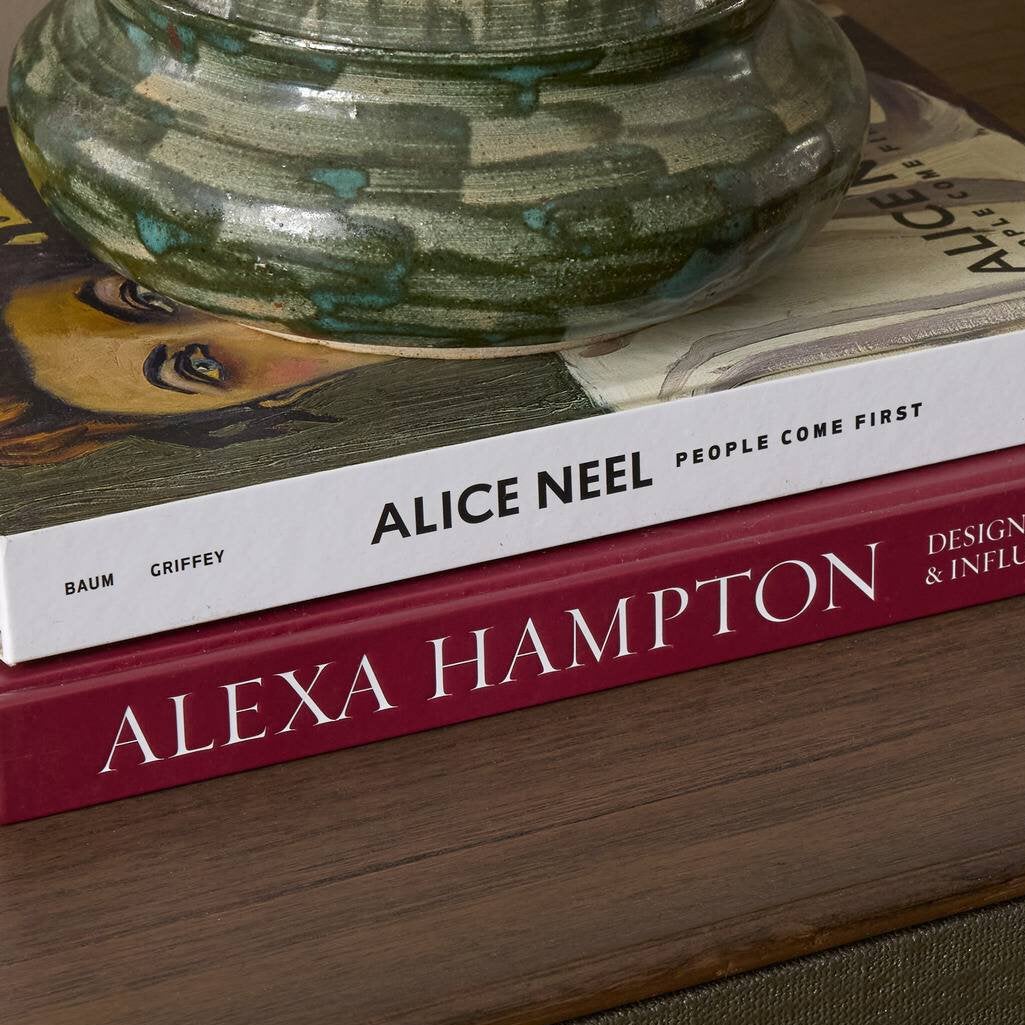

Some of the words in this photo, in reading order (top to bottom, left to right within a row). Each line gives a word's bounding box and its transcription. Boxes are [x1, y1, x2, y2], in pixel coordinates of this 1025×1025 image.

[902, 159, 969, 199] COME
[676, 434, 769, 467] PEOPLE
[781, 418, 843, 445] COME
[855, 402, 923, 430] FIRST
[371, 476, 520, 545] ALICE
[537, 451, 653, 510] NEEL
[64, 573, 115, 596] BAUM
[150, 549, 225, 577] GRIFFEY
[925, 566, 944, 586] &
[97, 653, 395, 775] ALEXA
[426, 541, 884, 701] HAMPTON
